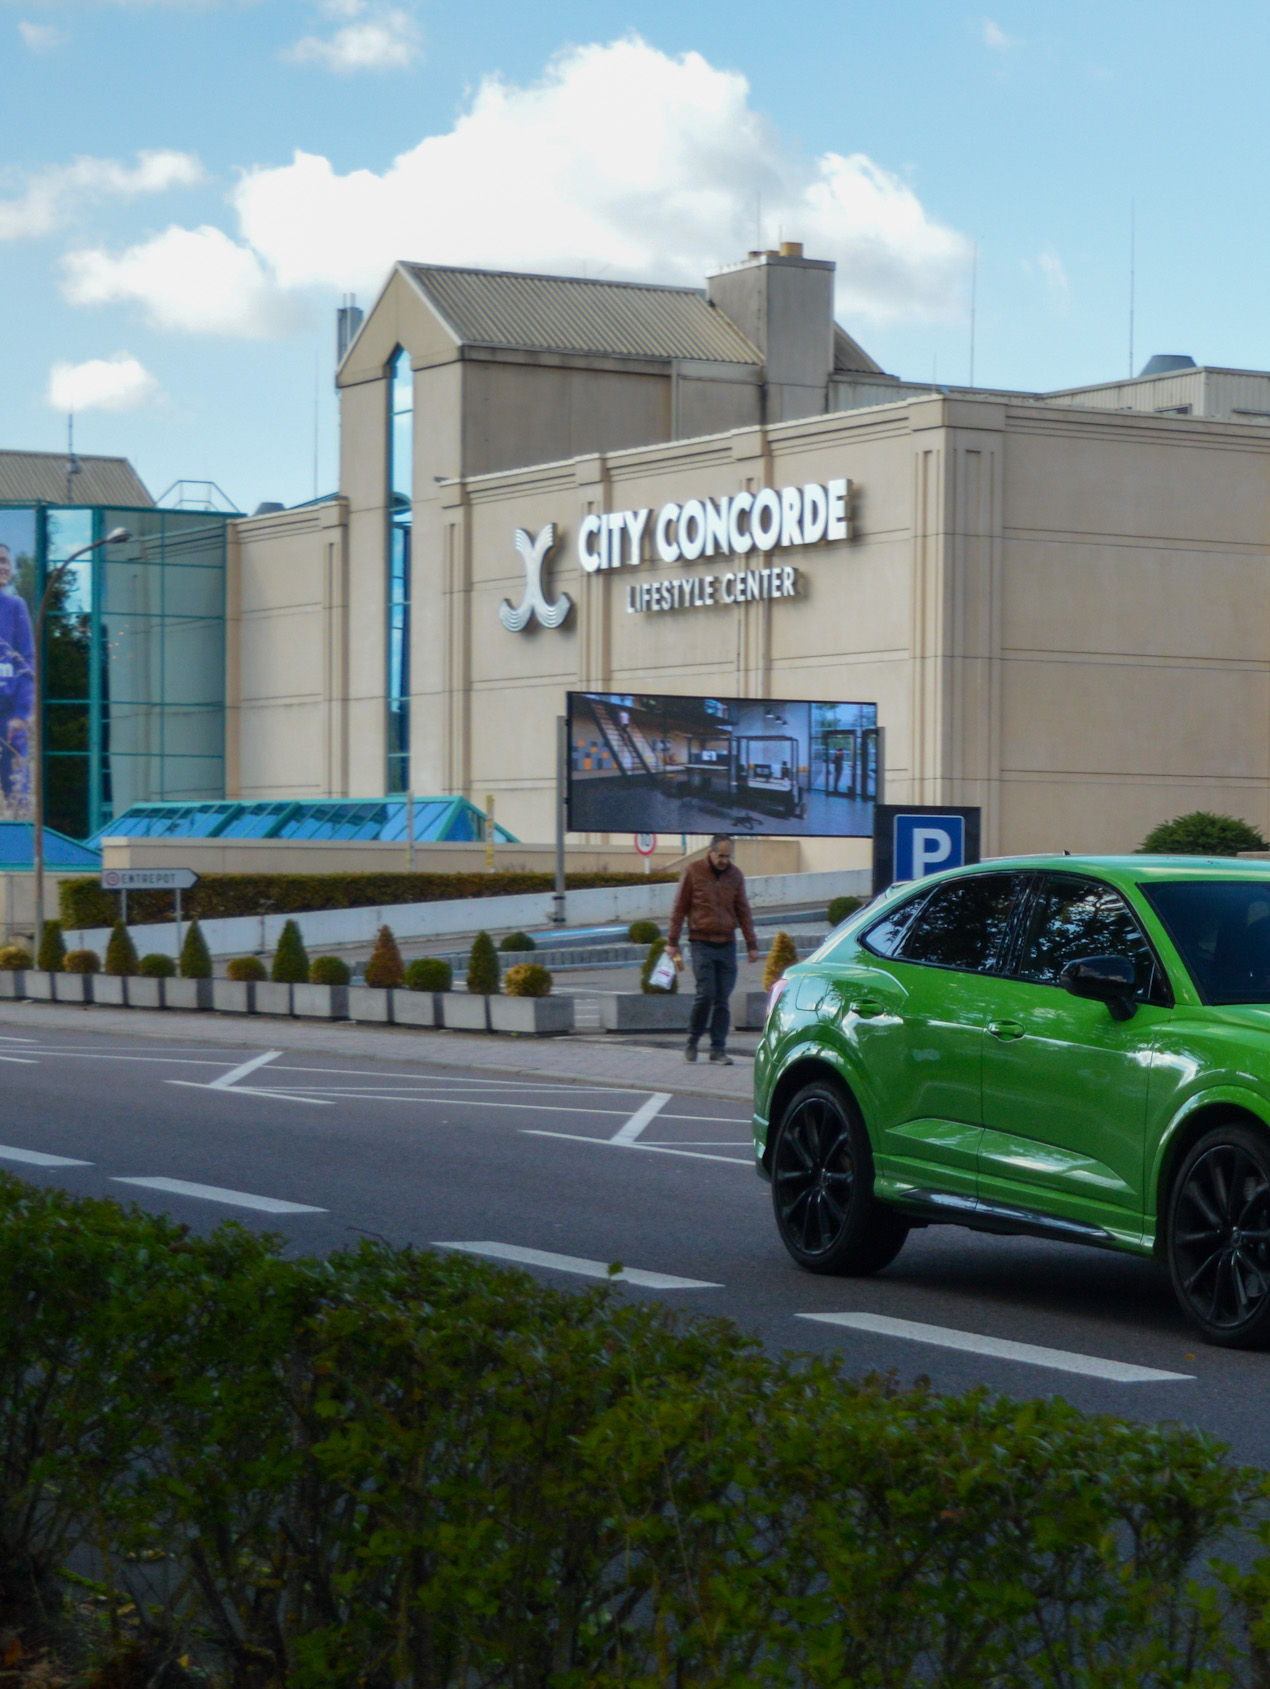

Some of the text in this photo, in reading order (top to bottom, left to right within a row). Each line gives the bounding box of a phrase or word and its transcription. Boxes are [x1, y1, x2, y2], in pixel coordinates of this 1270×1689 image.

[578, 479, 850, 573] CITY CONCORDE
[626, 566, 796, 613] LIFESTYLE CENTER
[912, 828, 952, 881] P
